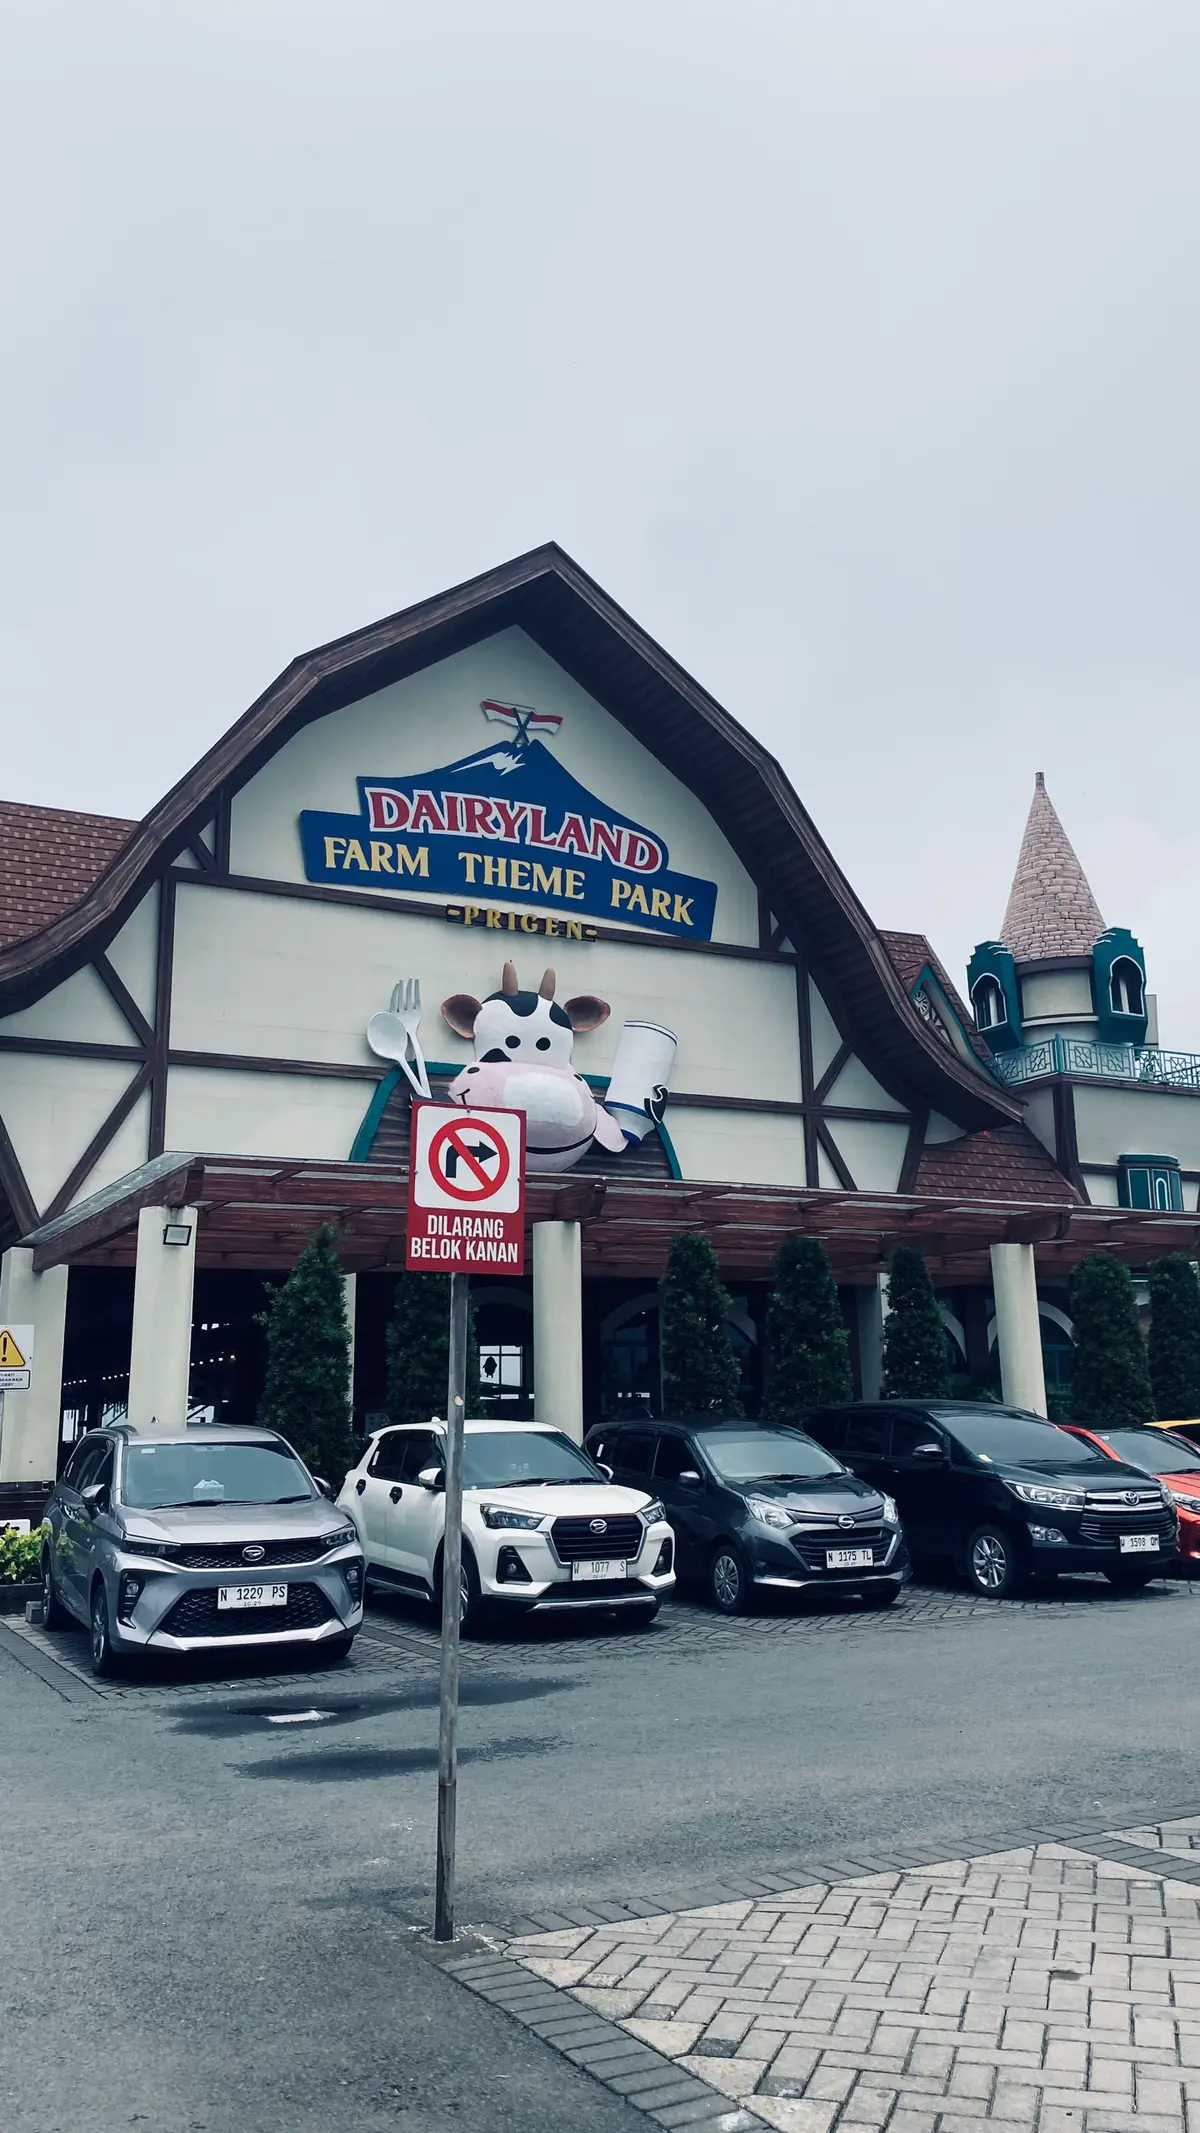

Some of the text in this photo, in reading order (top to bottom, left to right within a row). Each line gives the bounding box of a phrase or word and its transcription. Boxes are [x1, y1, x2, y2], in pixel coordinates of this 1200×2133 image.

[364, 787, 664, 874] DAIRYLAND
[324, 836, 694, 926] FARM THEME PARK
[427, 1214, 504, 1239] DILARANG
[411, 1237, 518, 1263] BELOK KANAN
[573, 1561, 625, 1574] W 1077 S
[838, 1551, 857, 1562] 1175
[862, 1550, 871, 1560] TL
[220, 1586, 286, 1601] N 1229 PS
